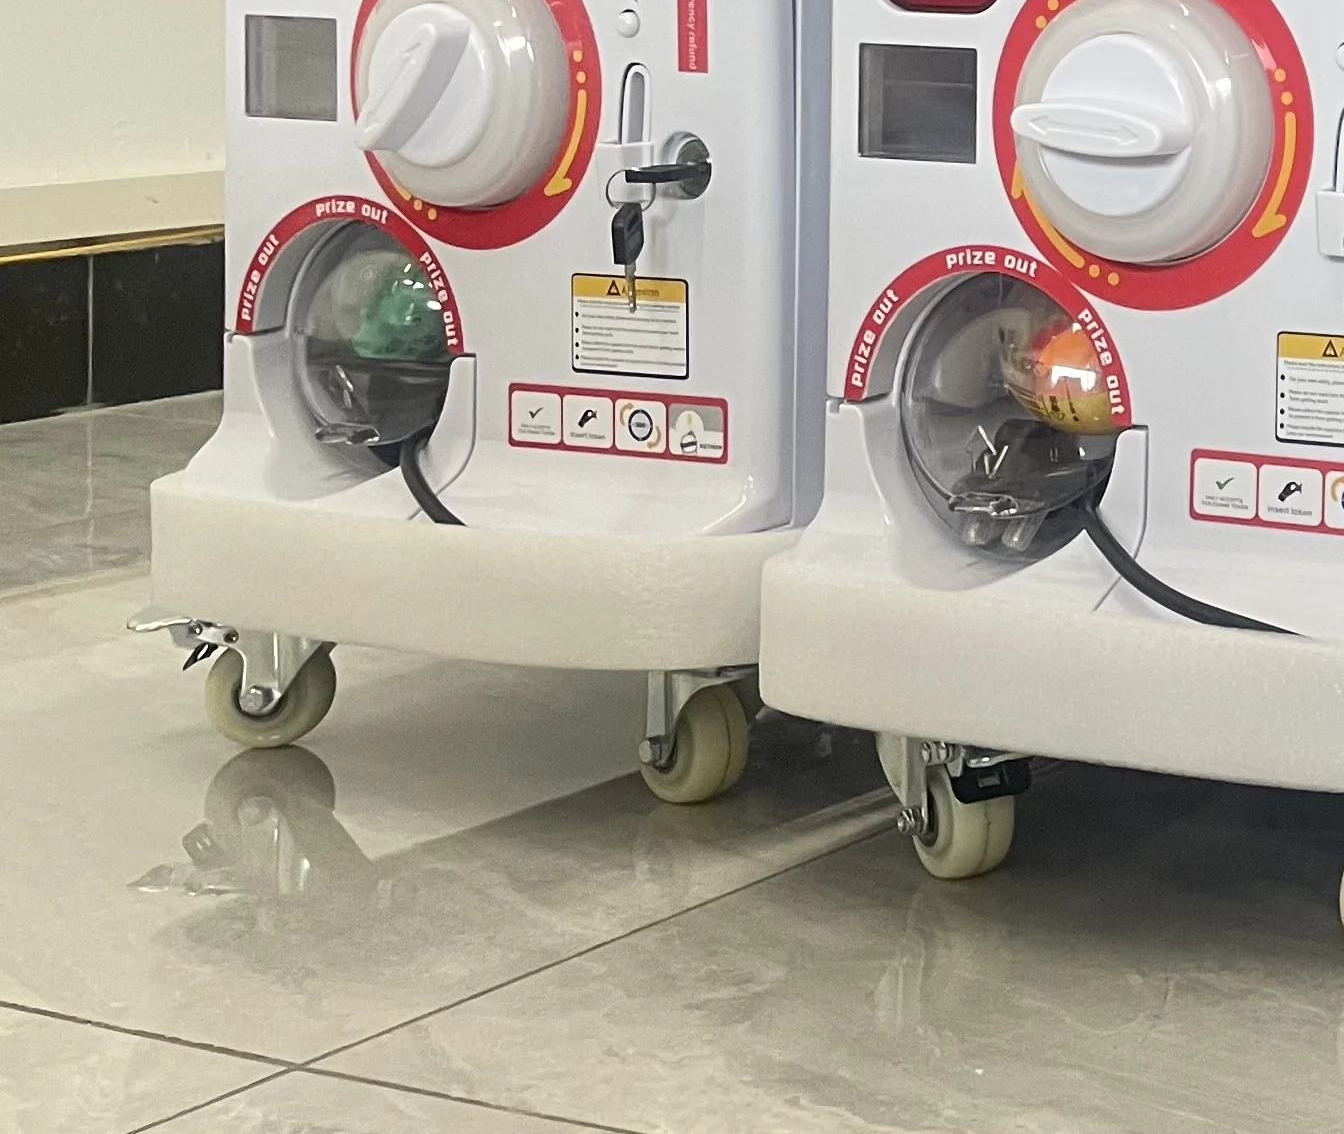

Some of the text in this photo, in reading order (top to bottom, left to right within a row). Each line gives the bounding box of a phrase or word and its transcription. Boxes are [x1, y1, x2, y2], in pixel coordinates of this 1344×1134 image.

[314, 198, 389, 225] prize out
[241, 234, 280, 322] prize out
[419, 251, 459, 346] prize out
[945, 249, 1038, 278] prize out
[850, 289, 899, 389] prize out
[1077, 308, 1125, 415] prize out
